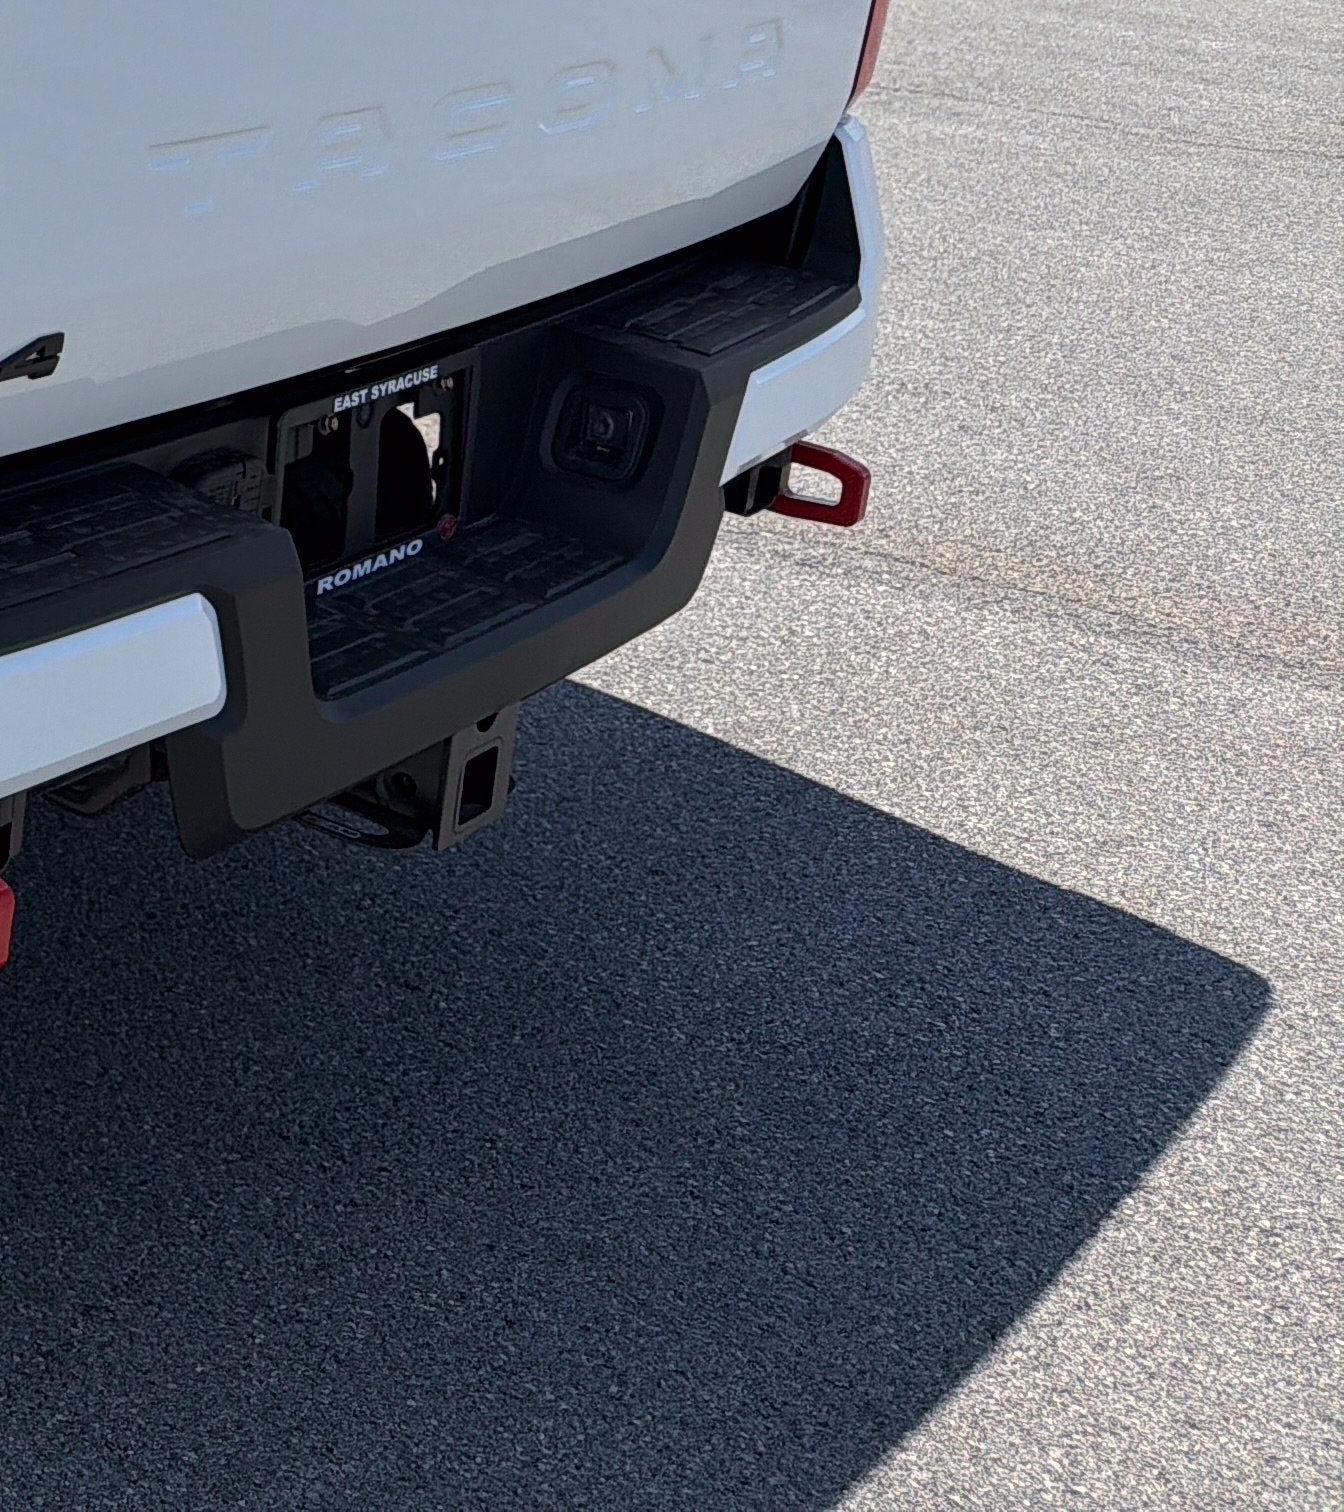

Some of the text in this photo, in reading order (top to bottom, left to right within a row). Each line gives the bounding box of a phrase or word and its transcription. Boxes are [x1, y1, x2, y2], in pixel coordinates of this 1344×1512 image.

[148, 18, 786, 213] TACOMA
[333, 364, 439, 413] EAST SYRACUSE
[316, 538, 424, 596] ROMANO
